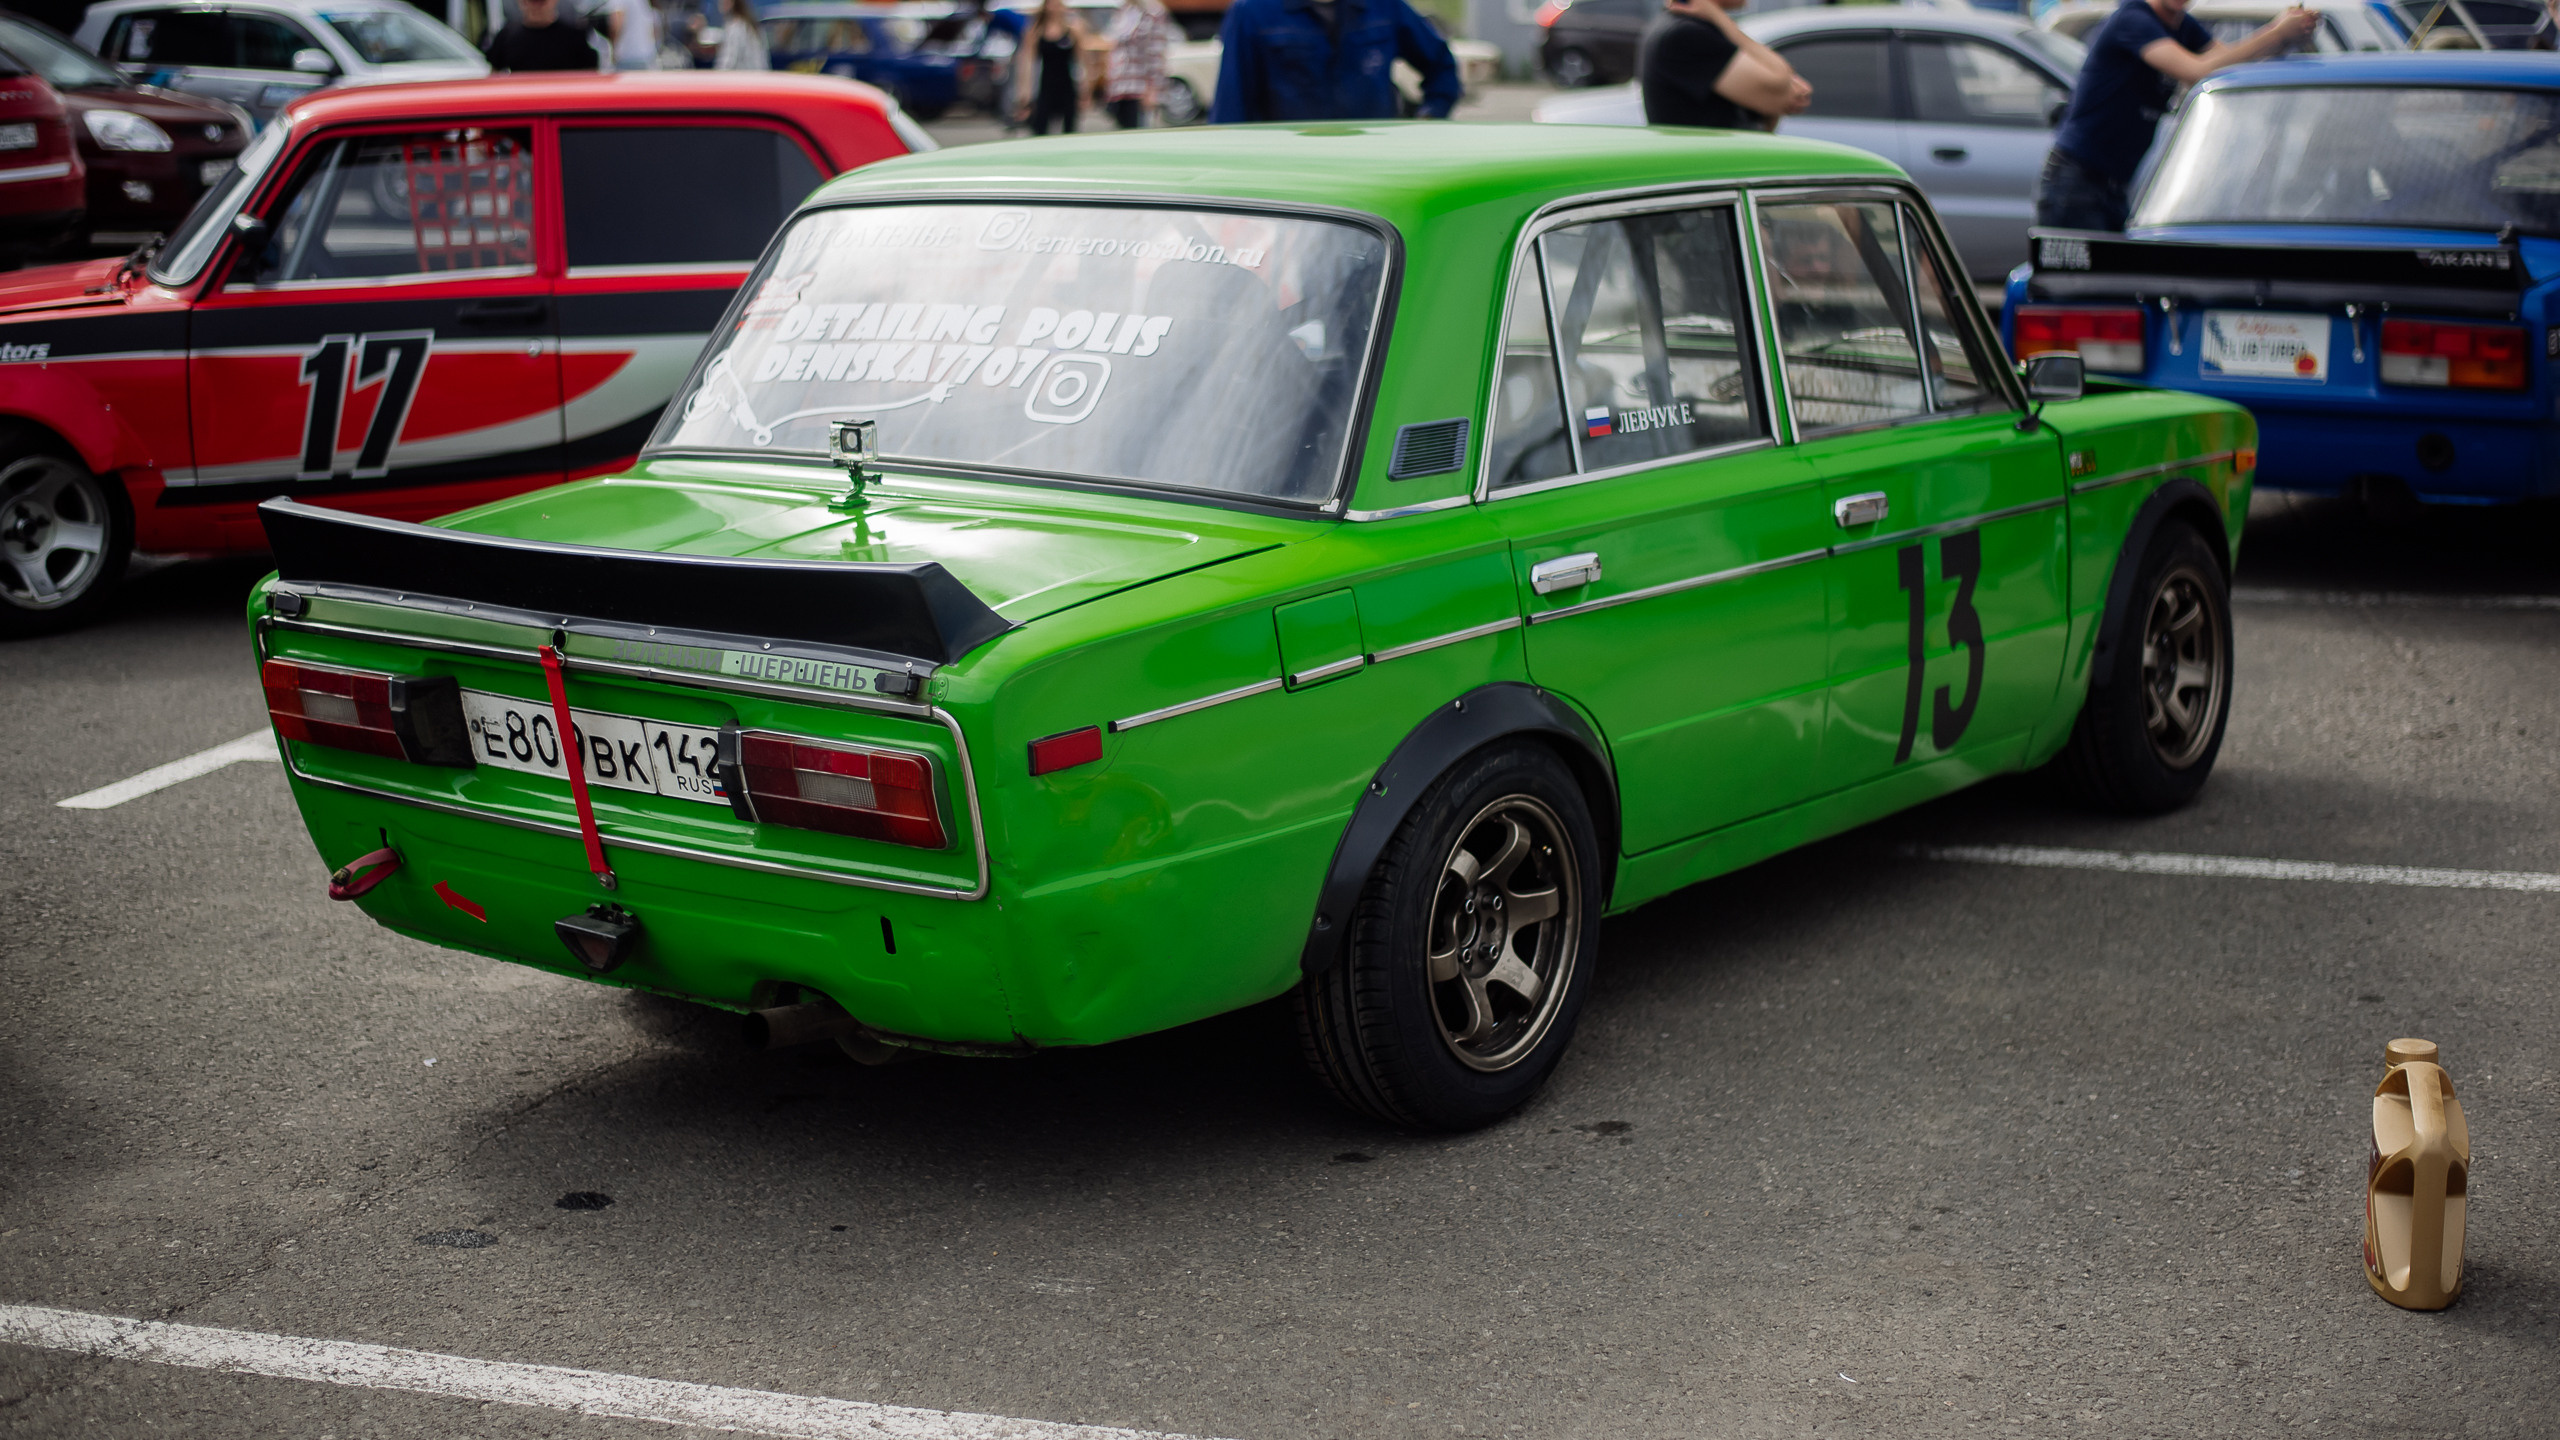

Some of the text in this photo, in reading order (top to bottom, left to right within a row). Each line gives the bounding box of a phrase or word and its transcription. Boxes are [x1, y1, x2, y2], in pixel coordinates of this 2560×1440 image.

[1015, 231, 1266, 268] kemerovosalon.ru
[776, 303, 1174, 358] DETAILING POLIS
[0, 341, 51, 362] tors
[752, 343, 1050, 388] DENISKA7707
[297, 328, 435, 480] 17
[1618, 401, 1696, 434] ЛЕВЧУК Е.
[1893, 529, 1986, 765] 13
[740, 654, 868, 691] ШЕРШЕНЬ
[481, 710, 720, 785] E80BK 142
[677, 774, 712, 795] RUS
